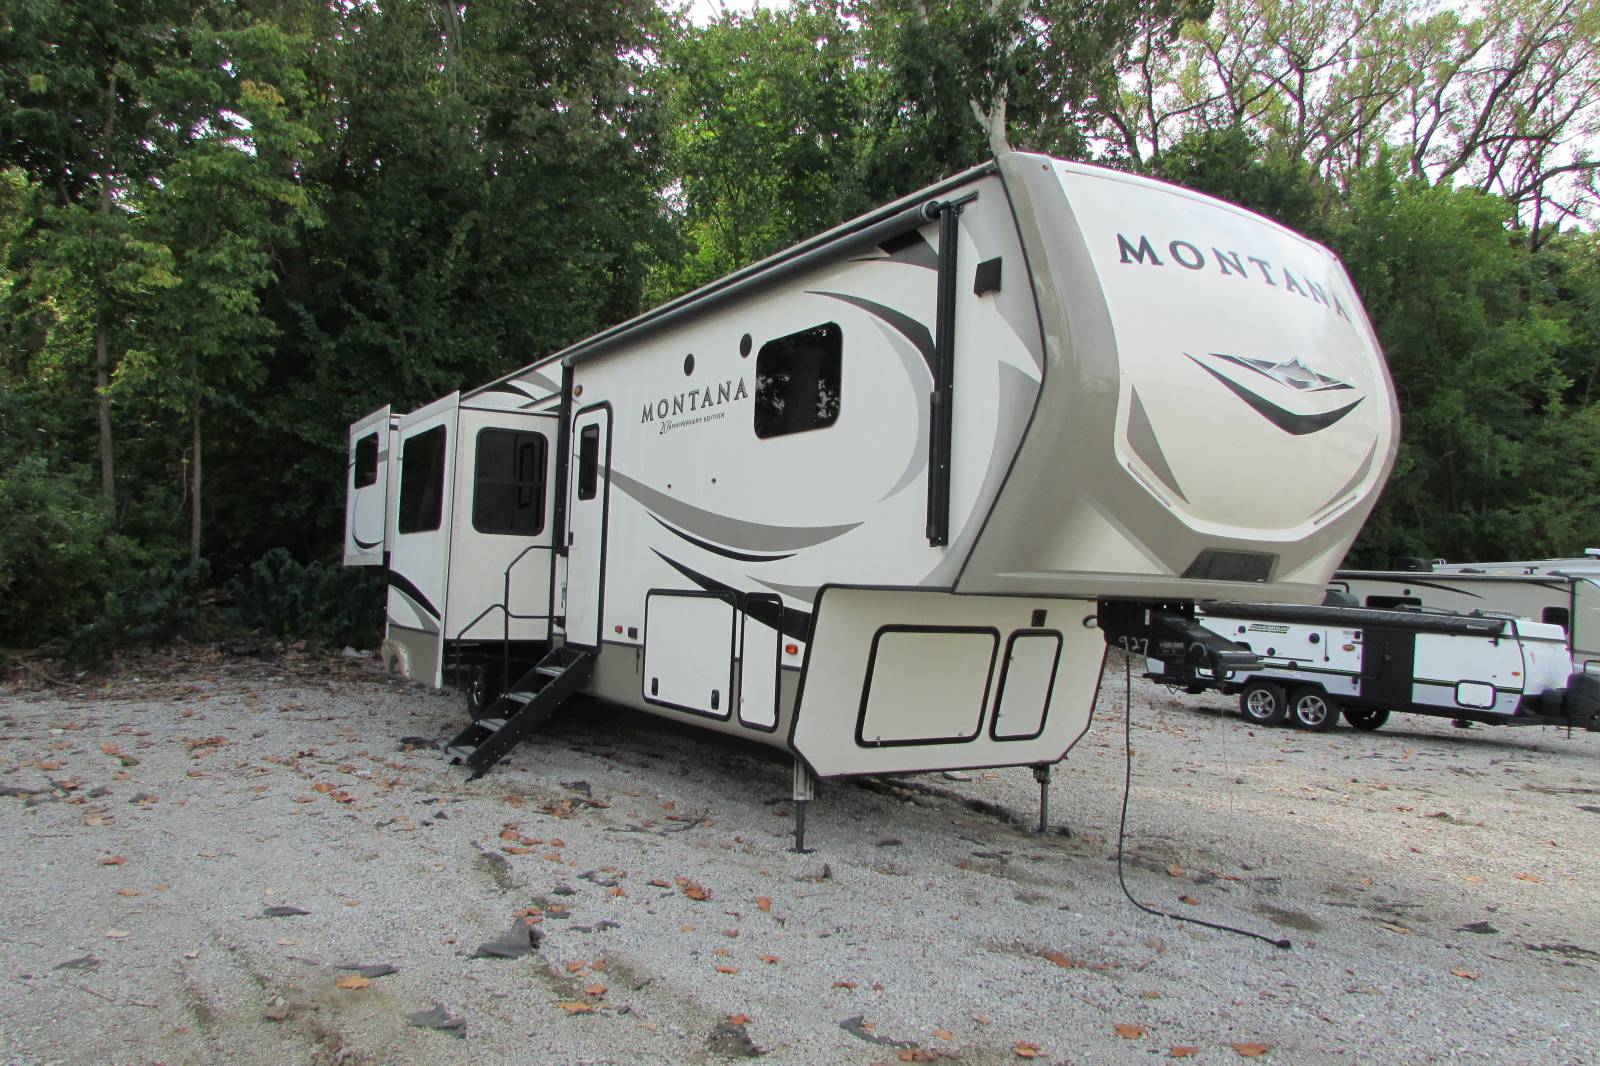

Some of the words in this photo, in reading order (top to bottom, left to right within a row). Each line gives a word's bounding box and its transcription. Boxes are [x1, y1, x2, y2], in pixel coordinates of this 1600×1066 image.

[1116, 232, 1352, 323] MONTANA
[641, 377, 749, 423] MONTANA
[668, 417, 702, 430] ANNIVERSARY
[703, 412, 725, 423] EDITION
[1118, 635, 1149, 658] 927
